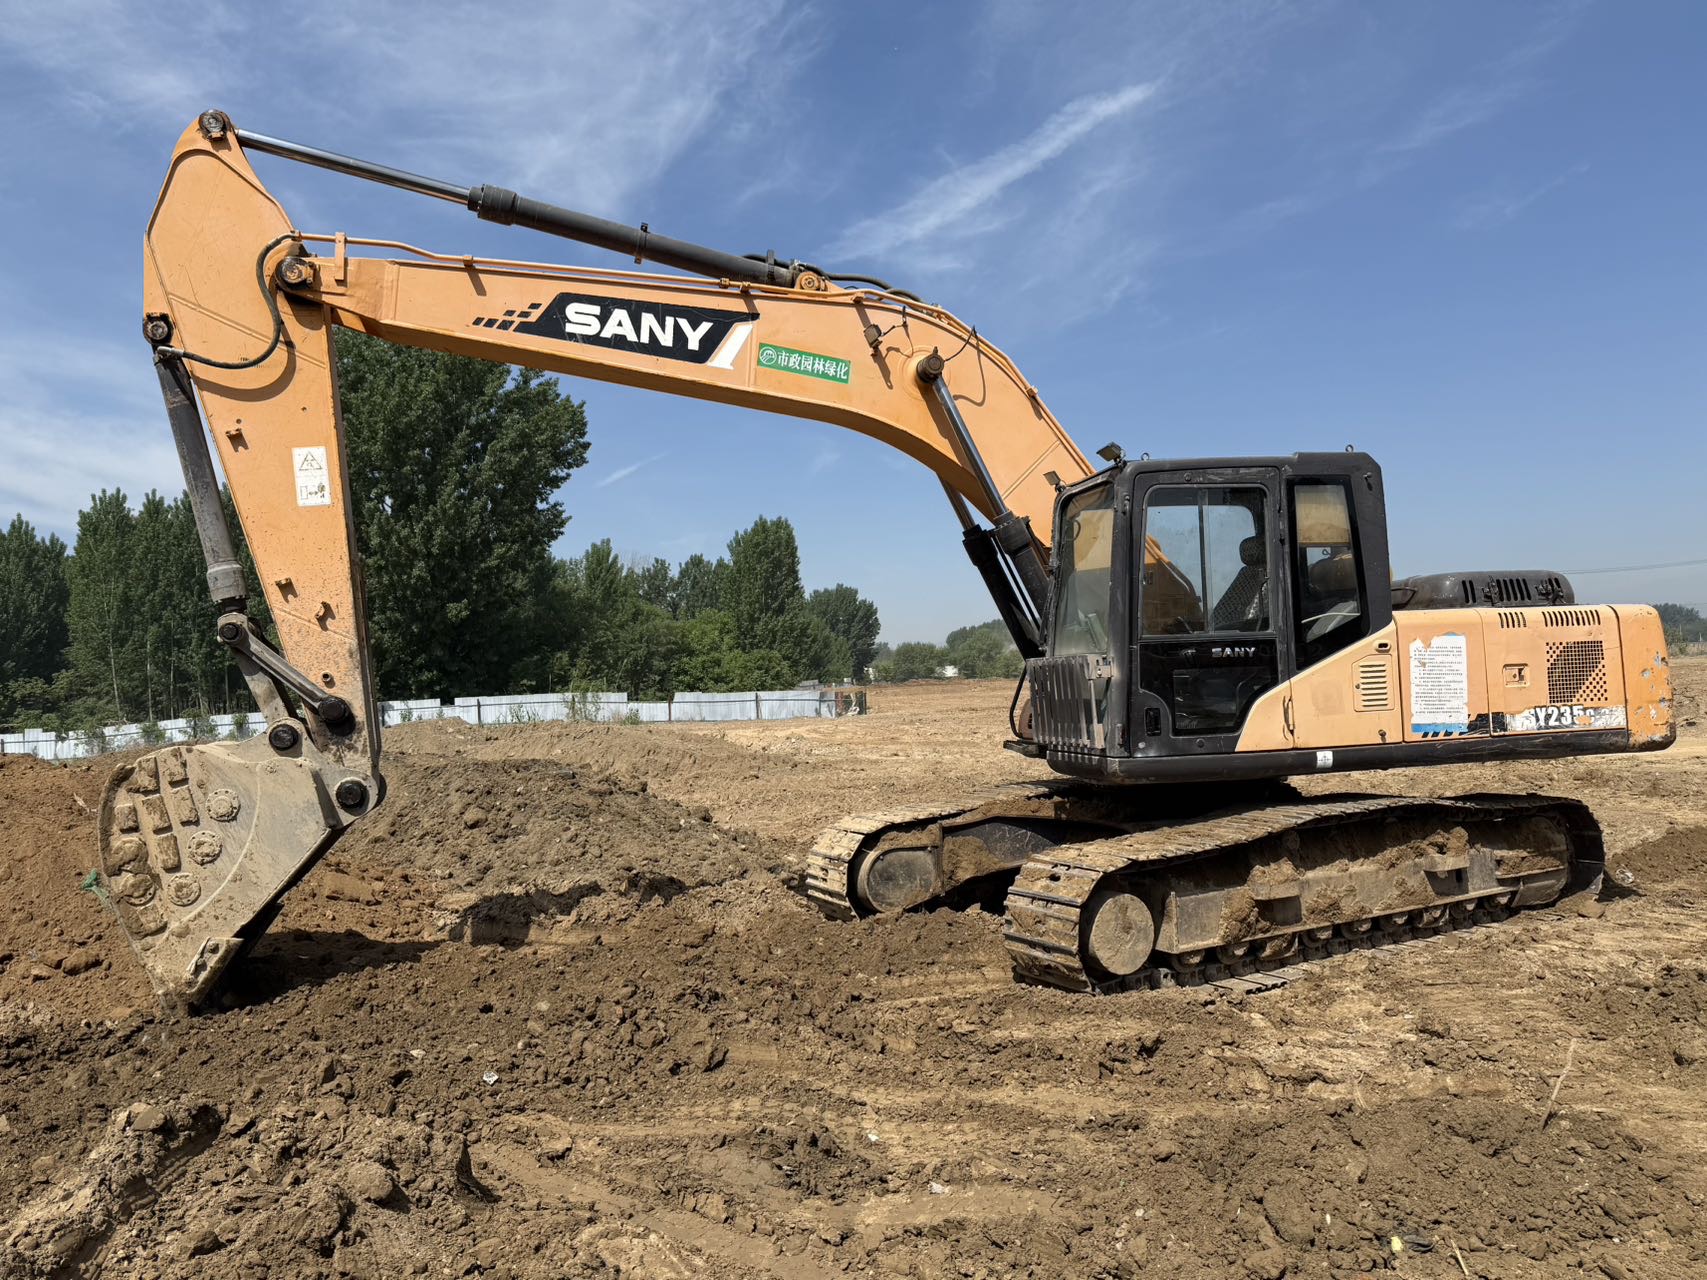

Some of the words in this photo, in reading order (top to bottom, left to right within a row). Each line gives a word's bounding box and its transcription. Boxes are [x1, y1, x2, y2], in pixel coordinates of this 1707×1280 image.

[565, 302, 714, 351] SANY
[777, 350, 849, 380] 市政园林绿化
[1211, 647, 1256, 658] SANY
